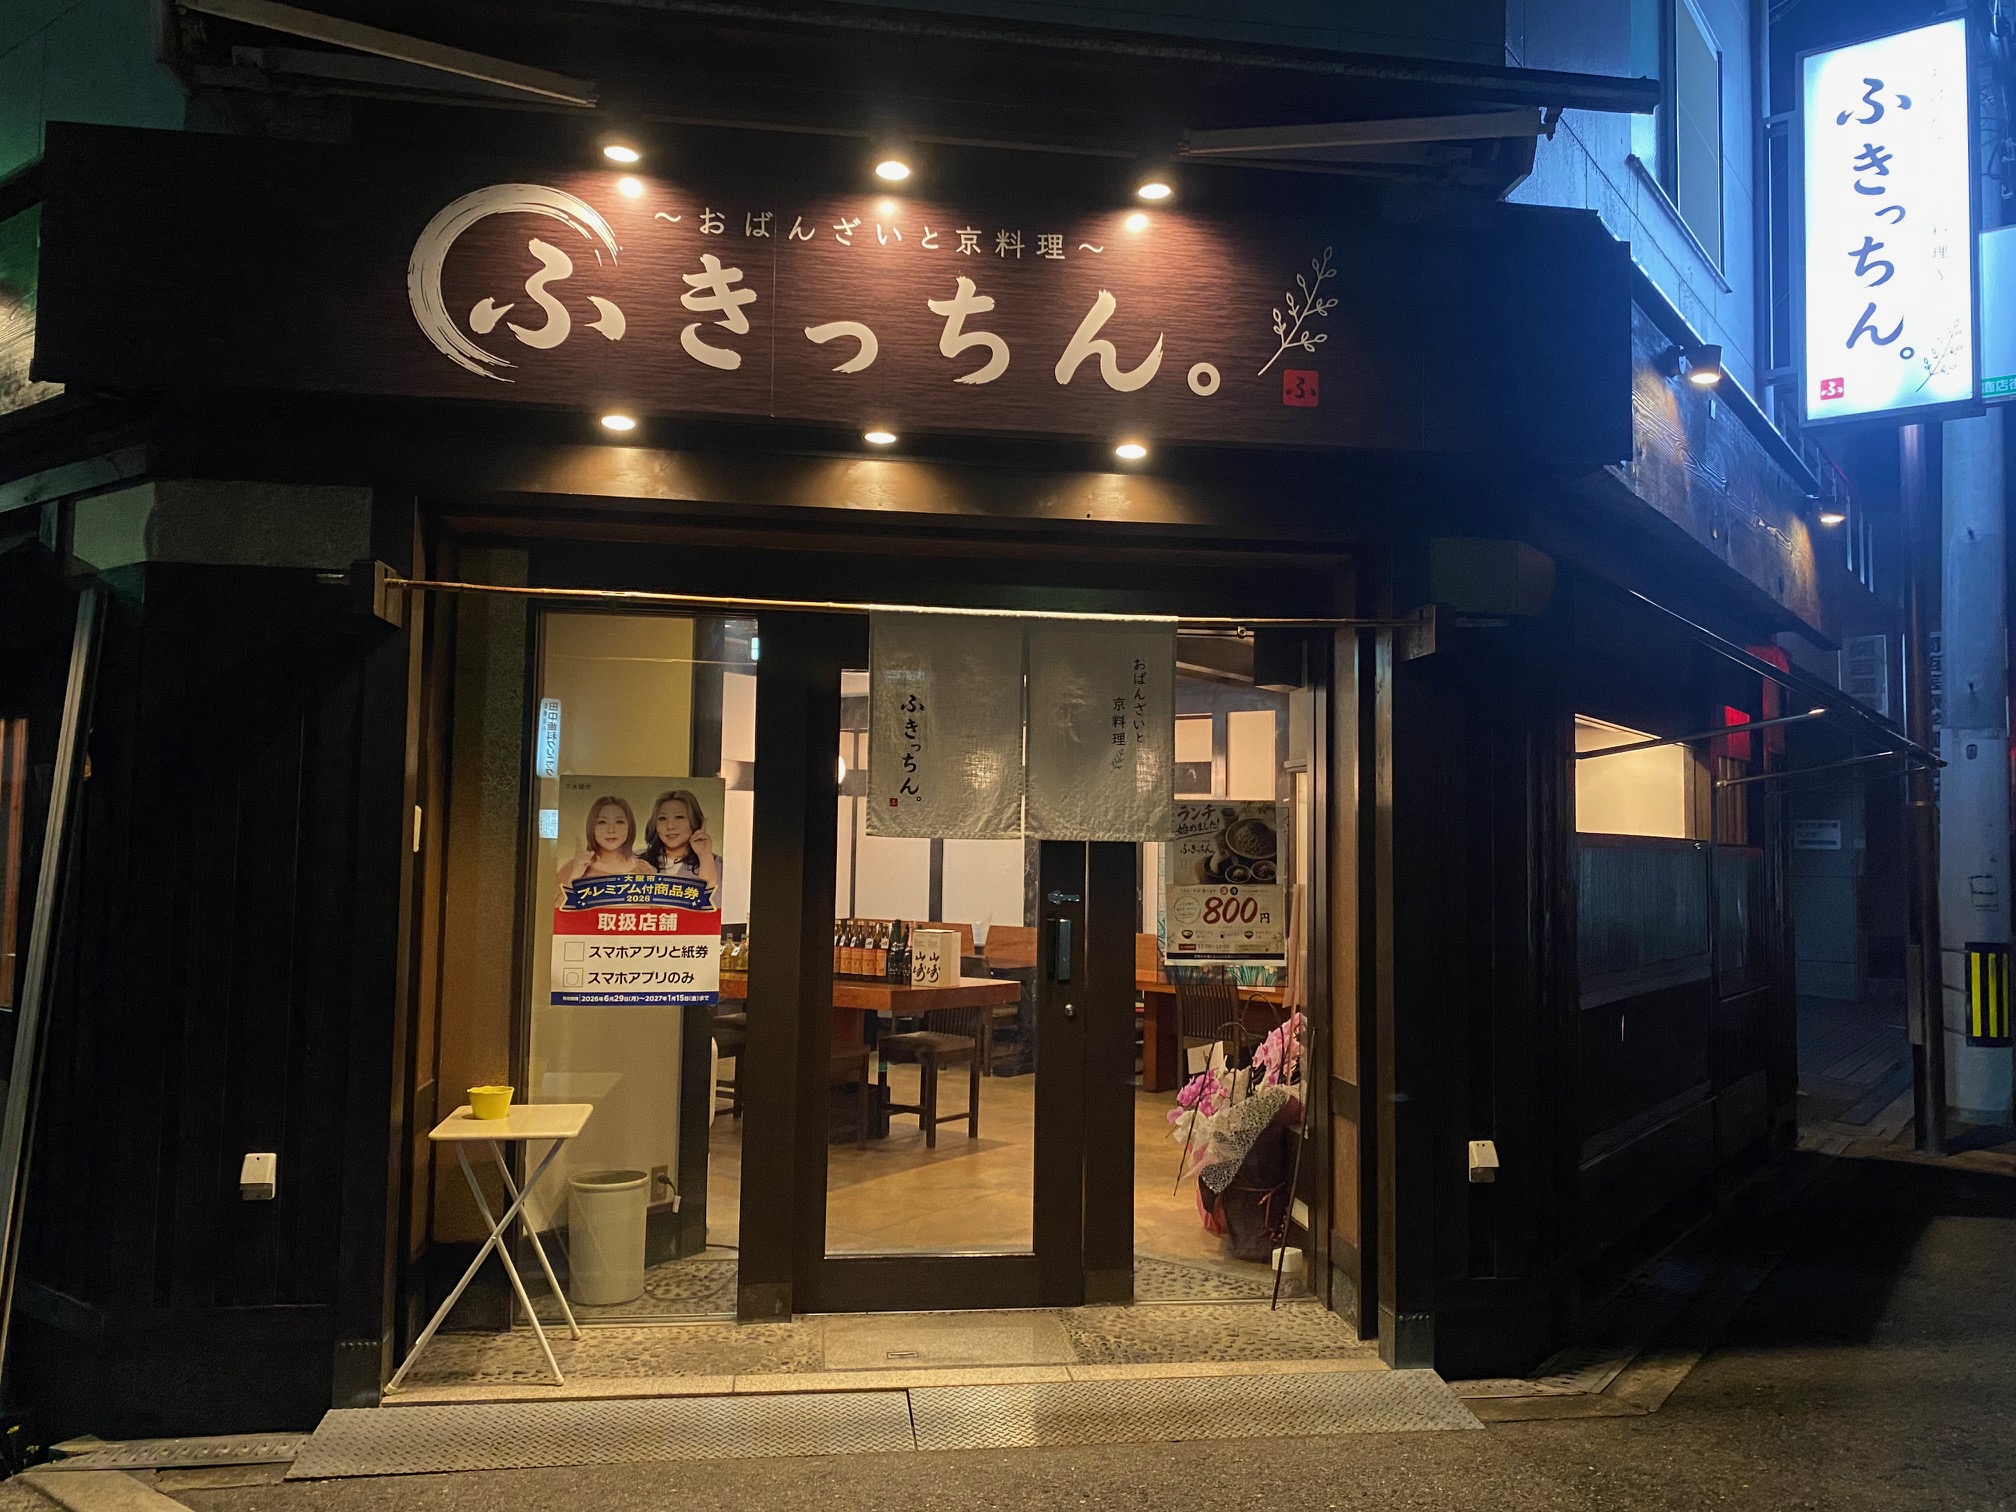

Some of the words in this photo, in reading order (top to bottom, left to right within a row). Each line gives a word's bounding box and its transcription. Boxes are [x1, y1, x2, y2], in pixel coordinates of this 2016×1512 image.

[1836, 77, 1915, 361] ふきっちん。
[469, 237, 1221, 397] ふきっちん。
[1286, 376, 1317, 400] ふ
[1821, 381, 1844, 397] ふ
[1112, 696, 1126, 746] 京料理
[899, 694, 925, 802] ふきっちん。
[1177, 803, 1216, 822] ランチ
[624, 875, 655, 883] 大阪市
[577, 882, 700, 901] プレミアム付商品券
[626, 895, 650, 903] 2026
[598, 912, 678, 932] 取扱店舗
[588, 945, 709, 959] スマホアプリと紙券
[587, 970, 695, 985] スマホアプリのみ
